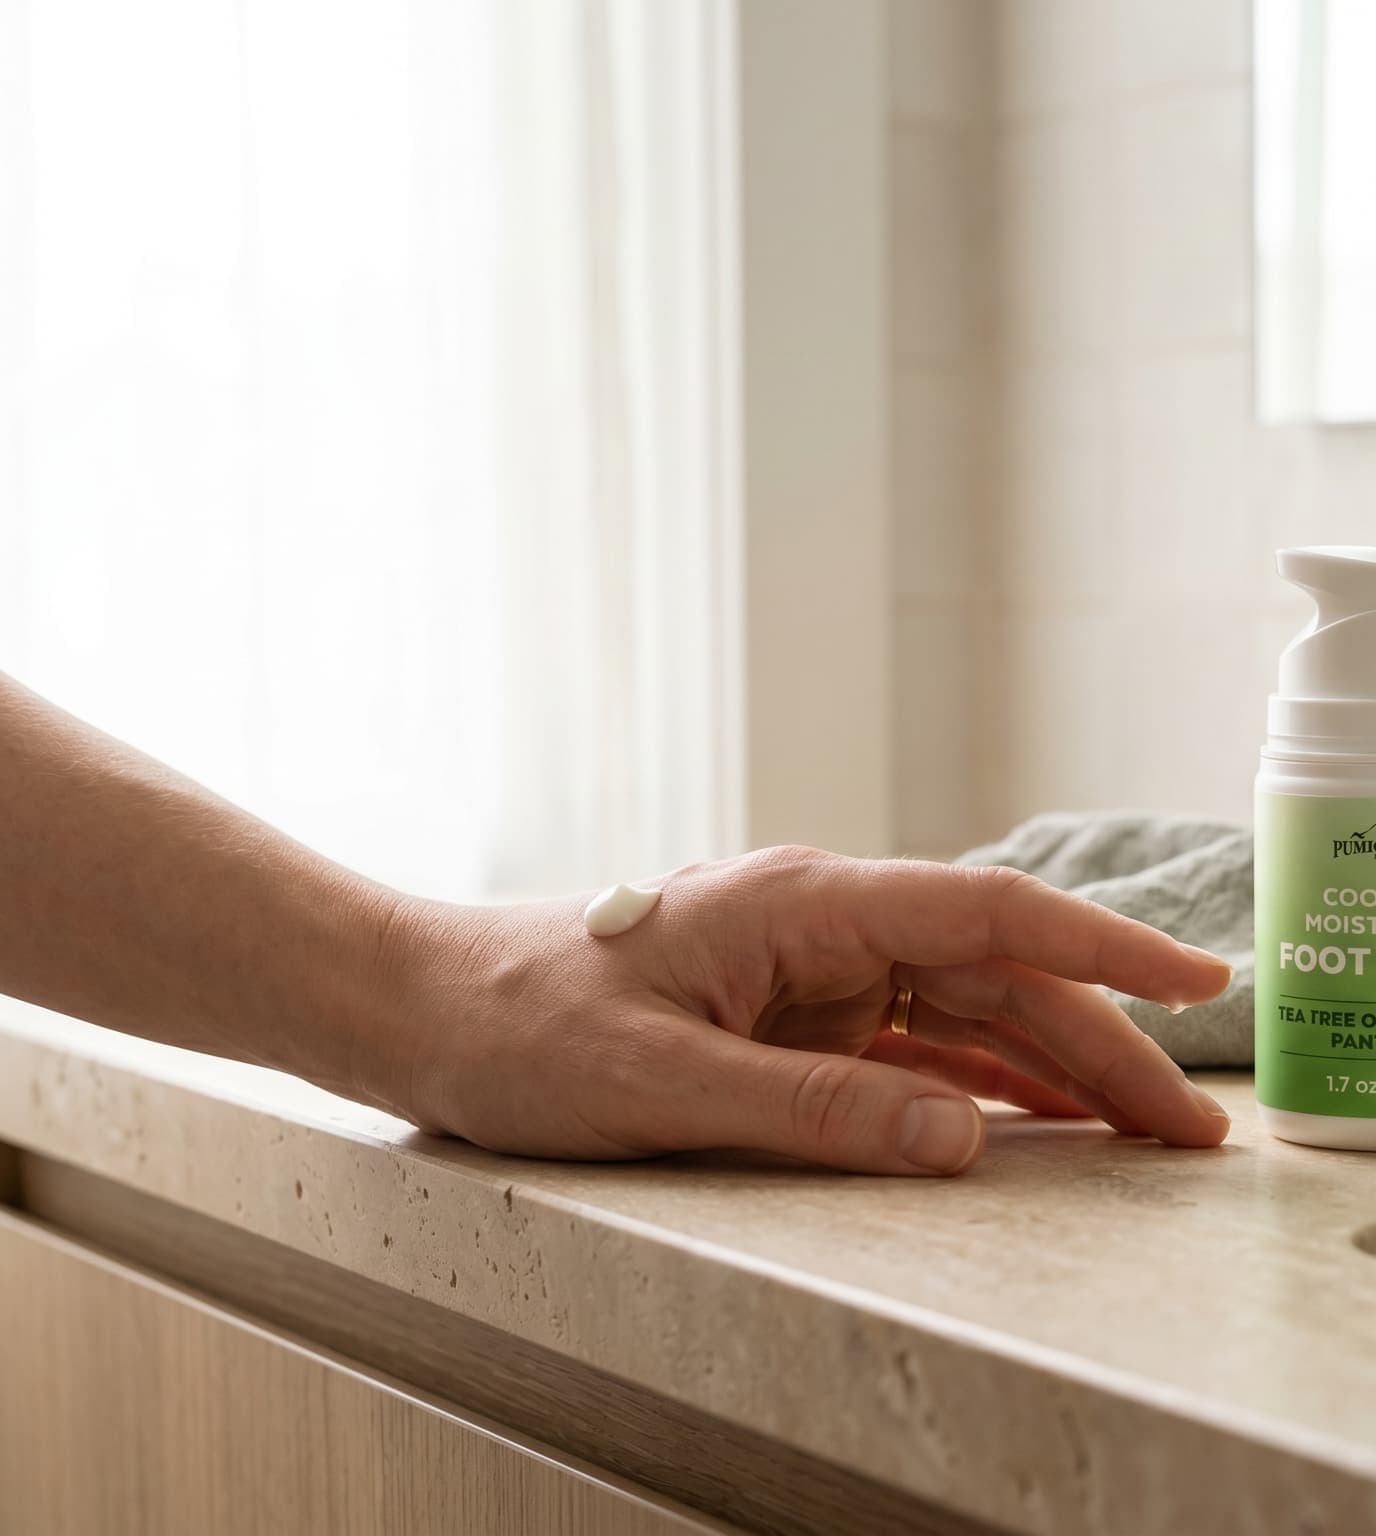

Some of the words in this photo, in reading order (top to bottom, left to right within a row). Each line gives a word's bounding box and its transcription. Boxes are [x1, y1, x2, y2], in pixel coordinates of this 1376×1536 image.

[1280, 941, 1371, 976] FOOT
[1278, 1005, 1306, 1024] TEA
[1311, 1009, 1356, 1027] TREE
[1326, 1075, 1350, 1093] 1.7
